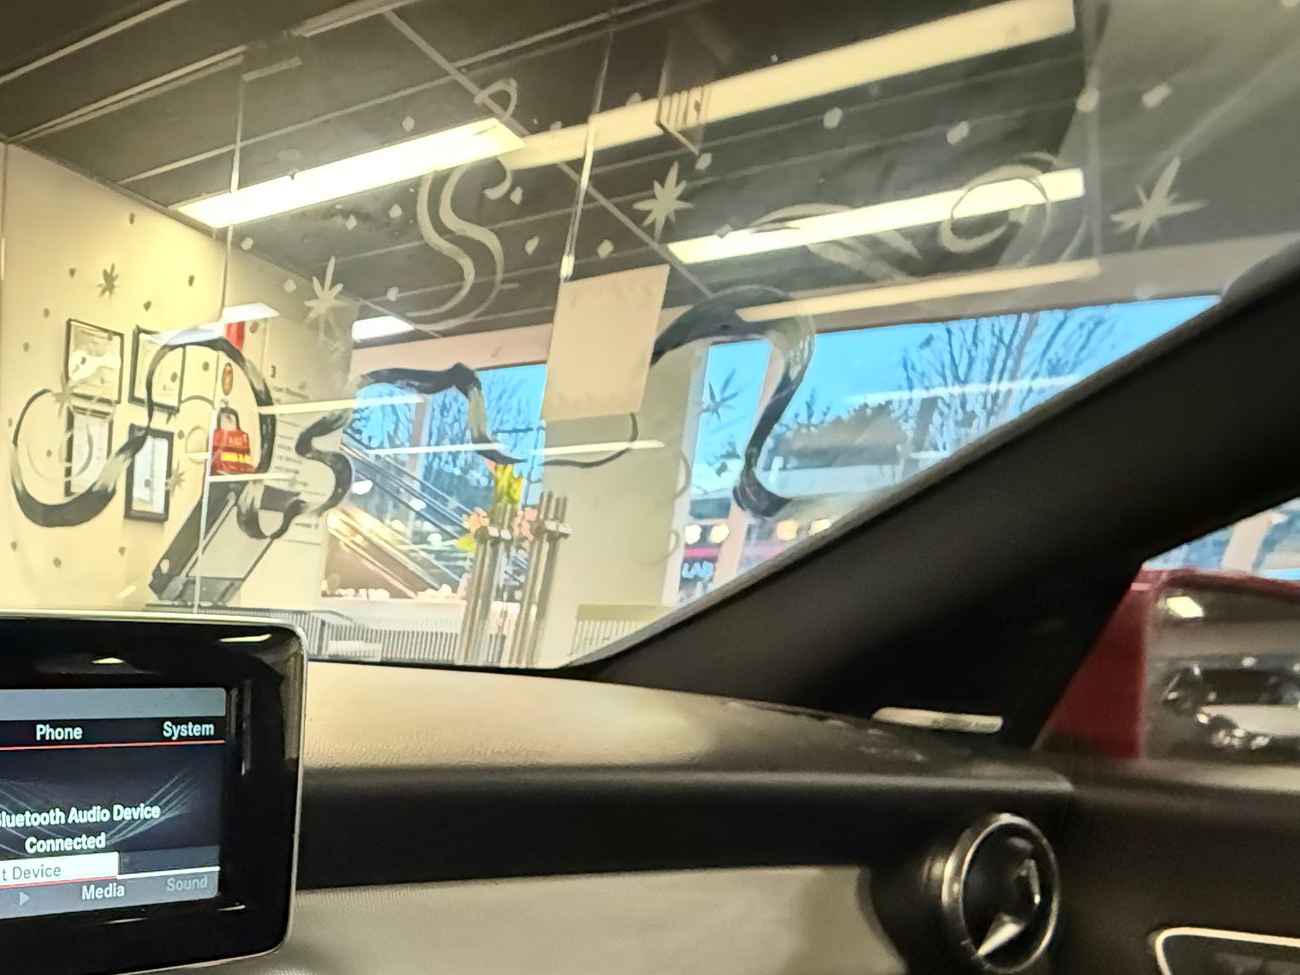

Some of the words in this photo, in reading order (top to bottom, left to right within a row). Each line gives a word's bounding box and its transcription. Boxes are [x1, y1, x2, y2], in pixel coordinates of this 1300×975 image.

[35, 724, 83, 741] Phone
[162, 721, 215, 738] System
[68, 805, 110, 825] Audio
[112, 803, 161, 821] Device
[25, 832, 106, 854] Connected
[12, 864, 61, 881] Device
[81, 882, 125, 901] Media
[166, 876, 208, 893] Sound
